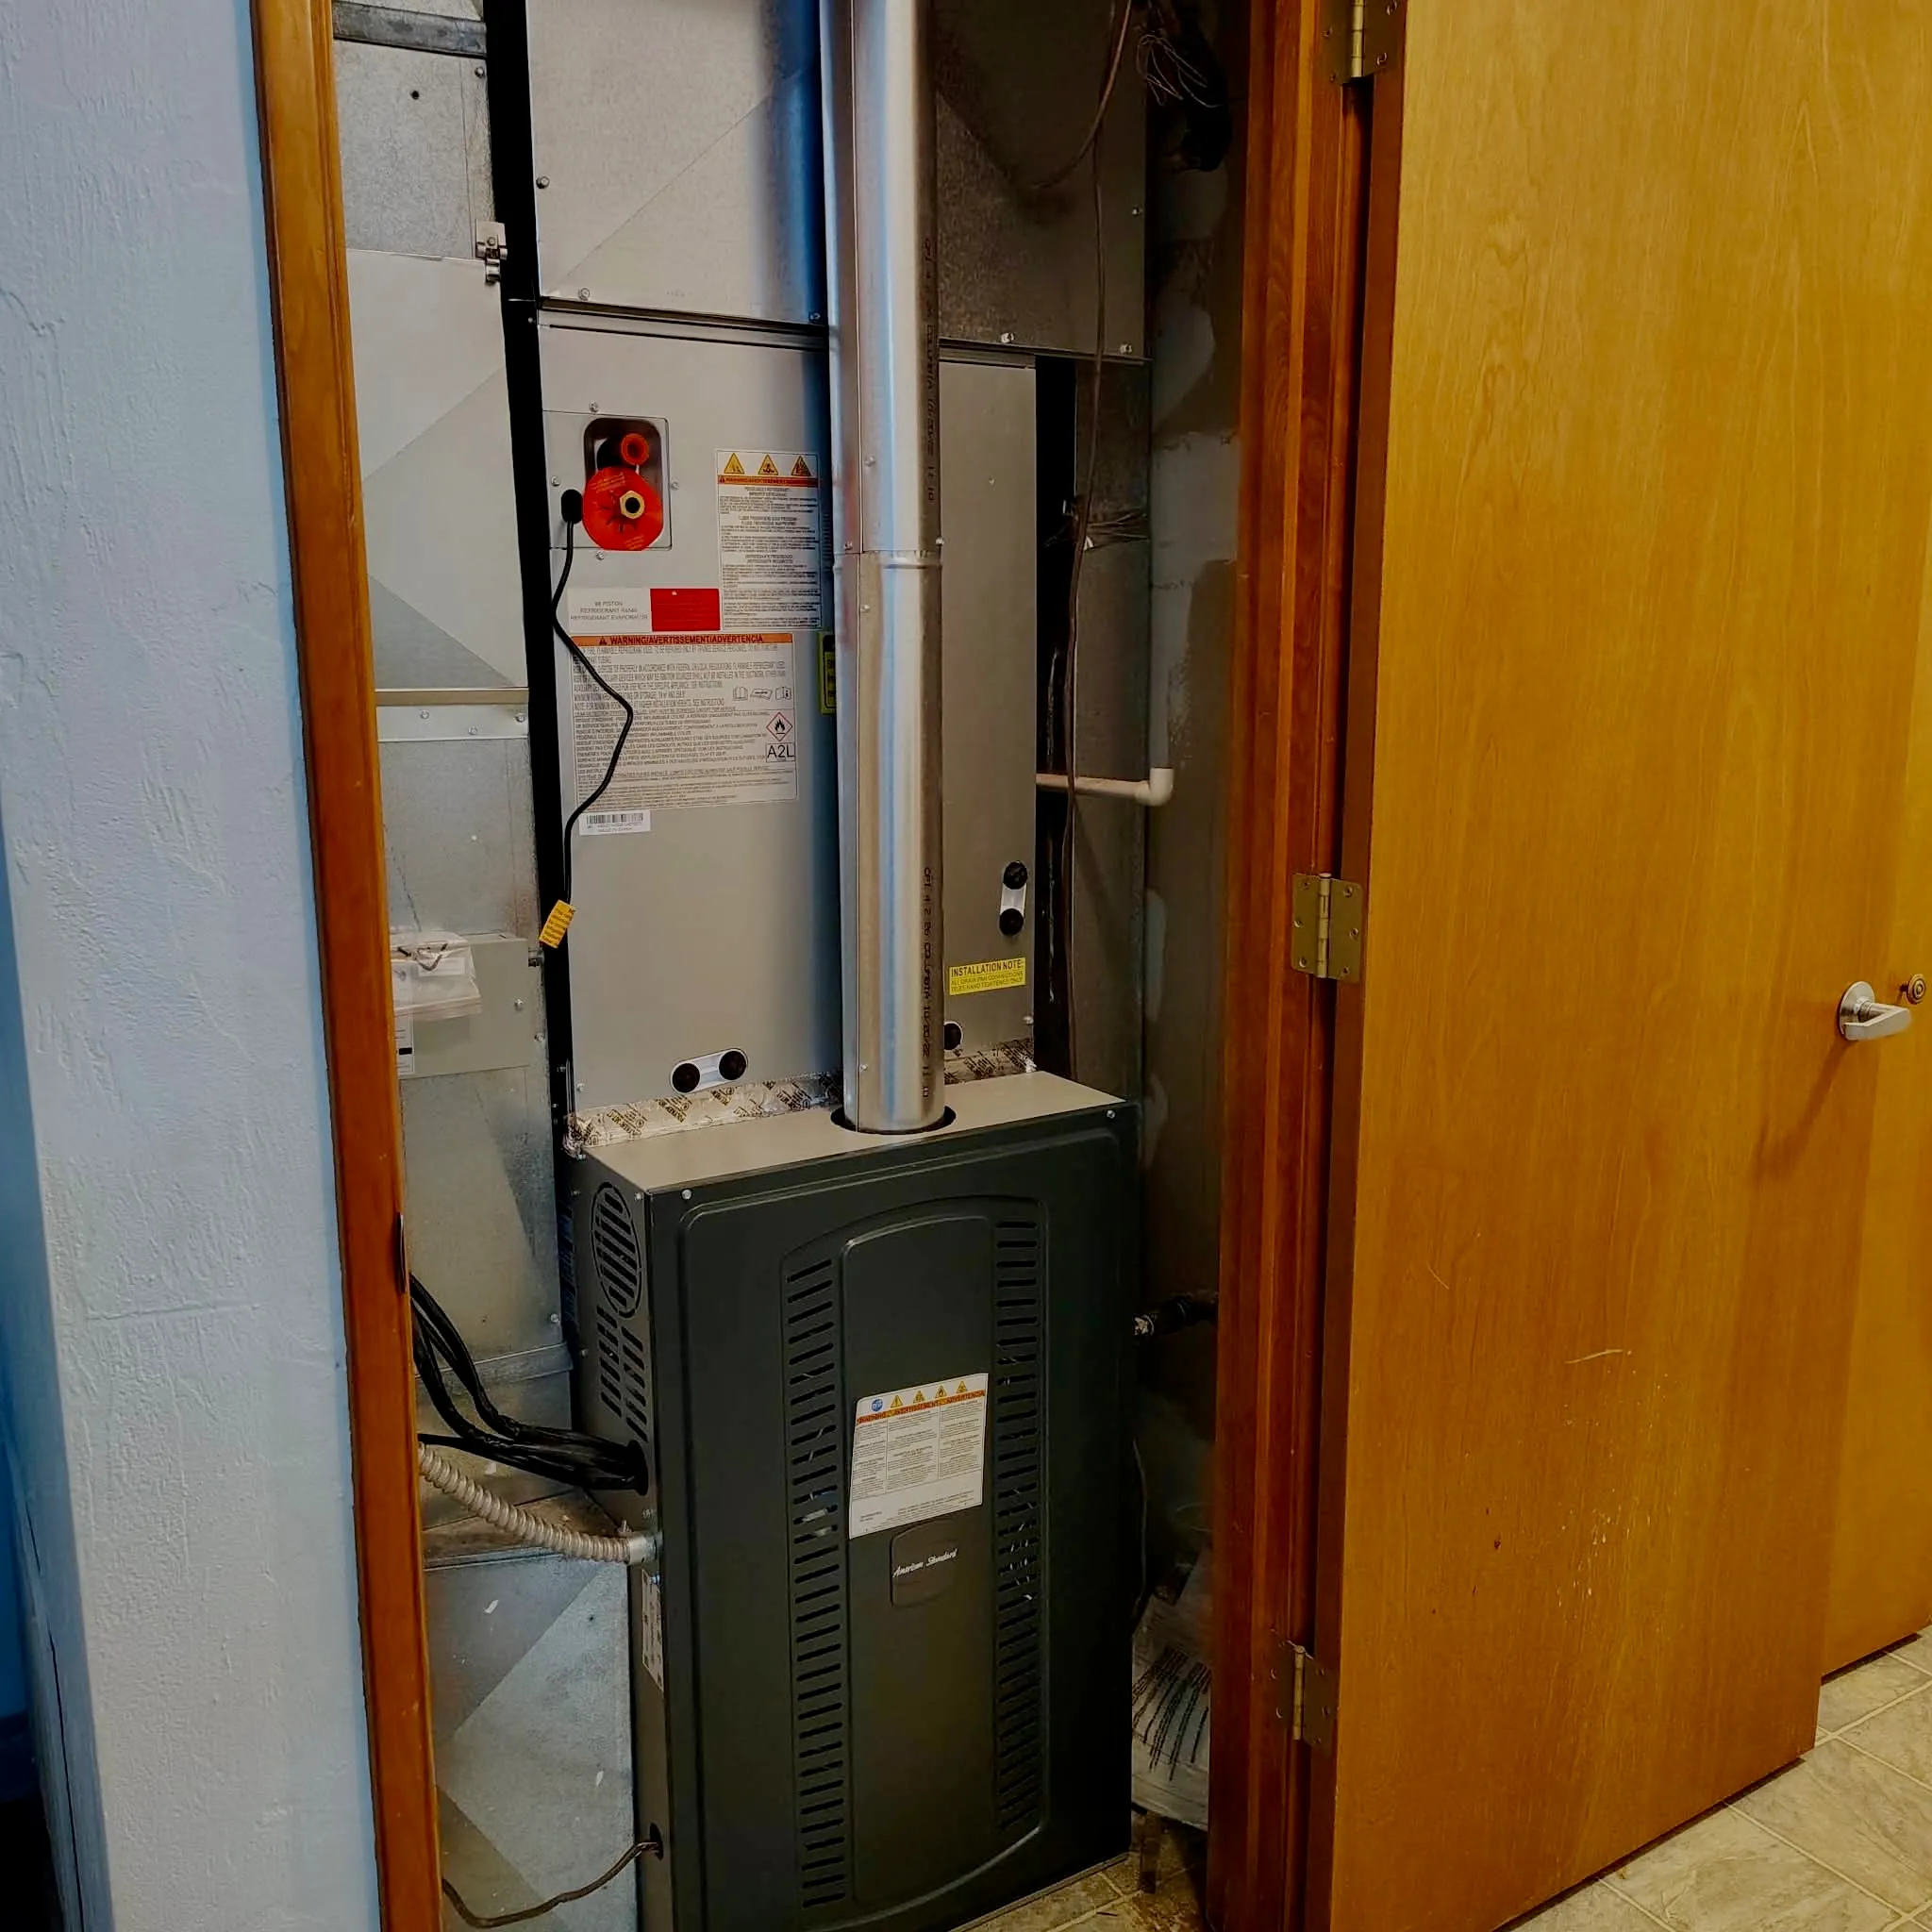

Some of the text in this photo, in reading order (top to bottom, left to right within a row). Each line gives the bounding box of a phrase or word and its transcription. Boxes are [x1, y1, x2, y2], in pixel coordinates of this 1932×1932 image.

[767, 744, 794, 758] A2L
[951, 958, 1022, 977] INSTALLATION NOTE
[926, 1548, 958, 1567] Standard
